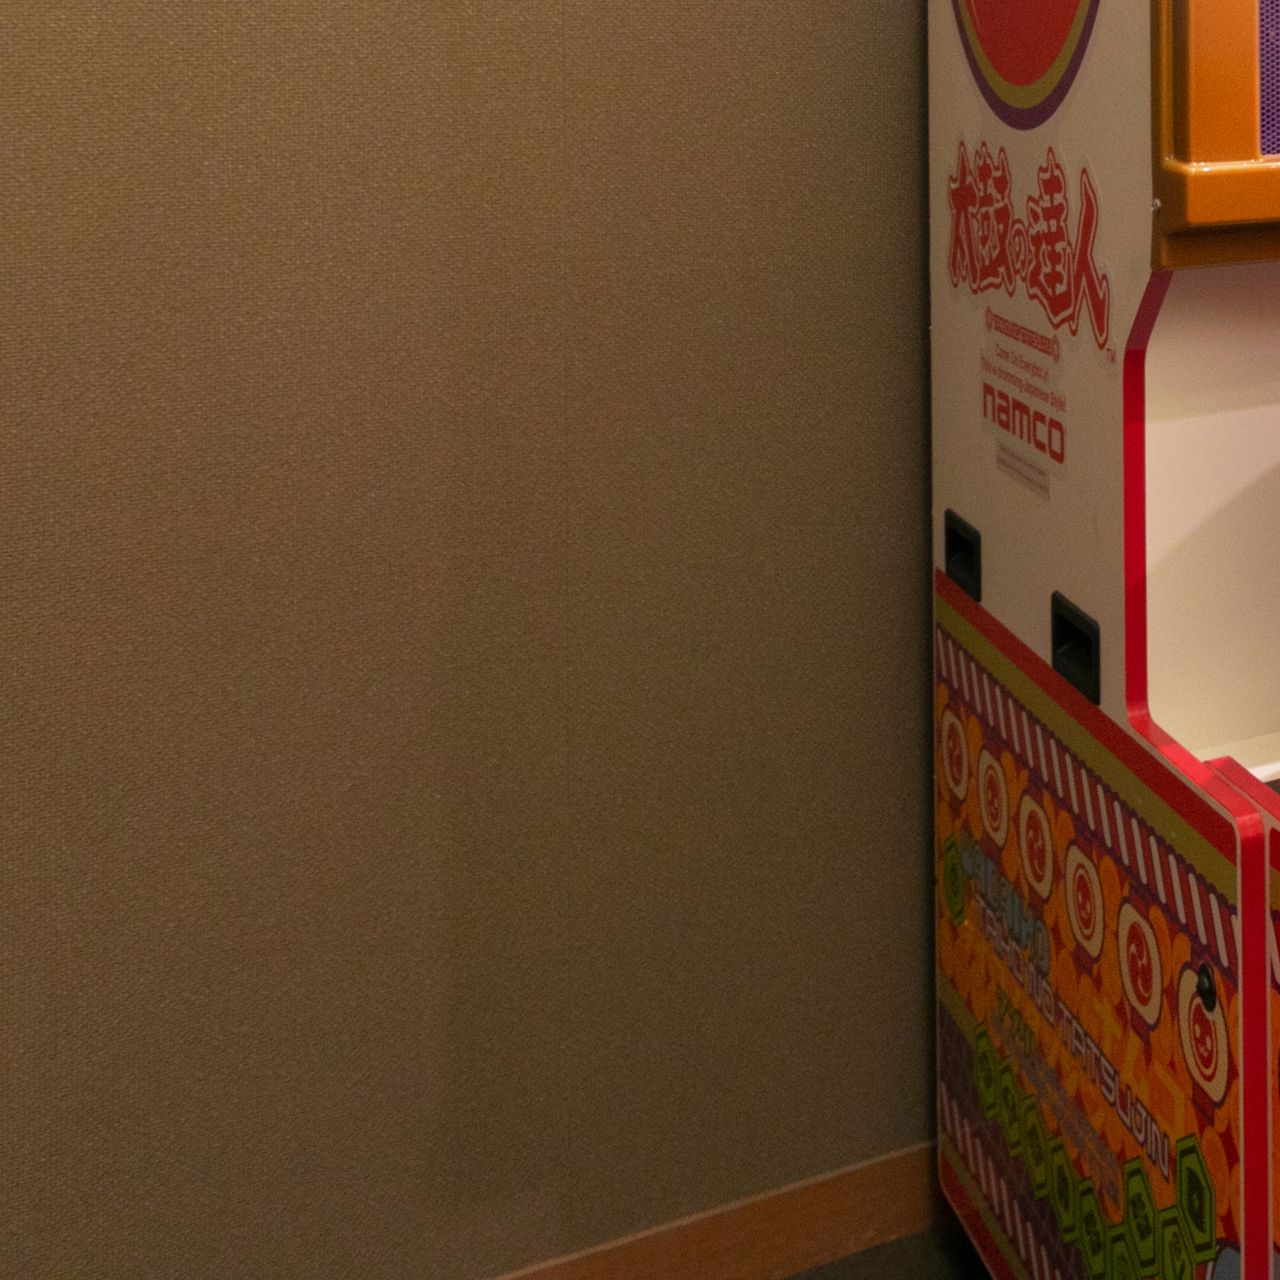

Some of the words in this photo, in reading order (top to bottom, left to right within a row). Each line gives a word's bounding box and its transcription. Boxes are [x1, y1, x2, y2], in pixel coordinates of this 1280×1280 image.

[948, 140, 1110, 349] 太鼓の達人
[983, 382, 1065, 464] namco
[1056, 996, 1169, 1180] TATSUJIN
